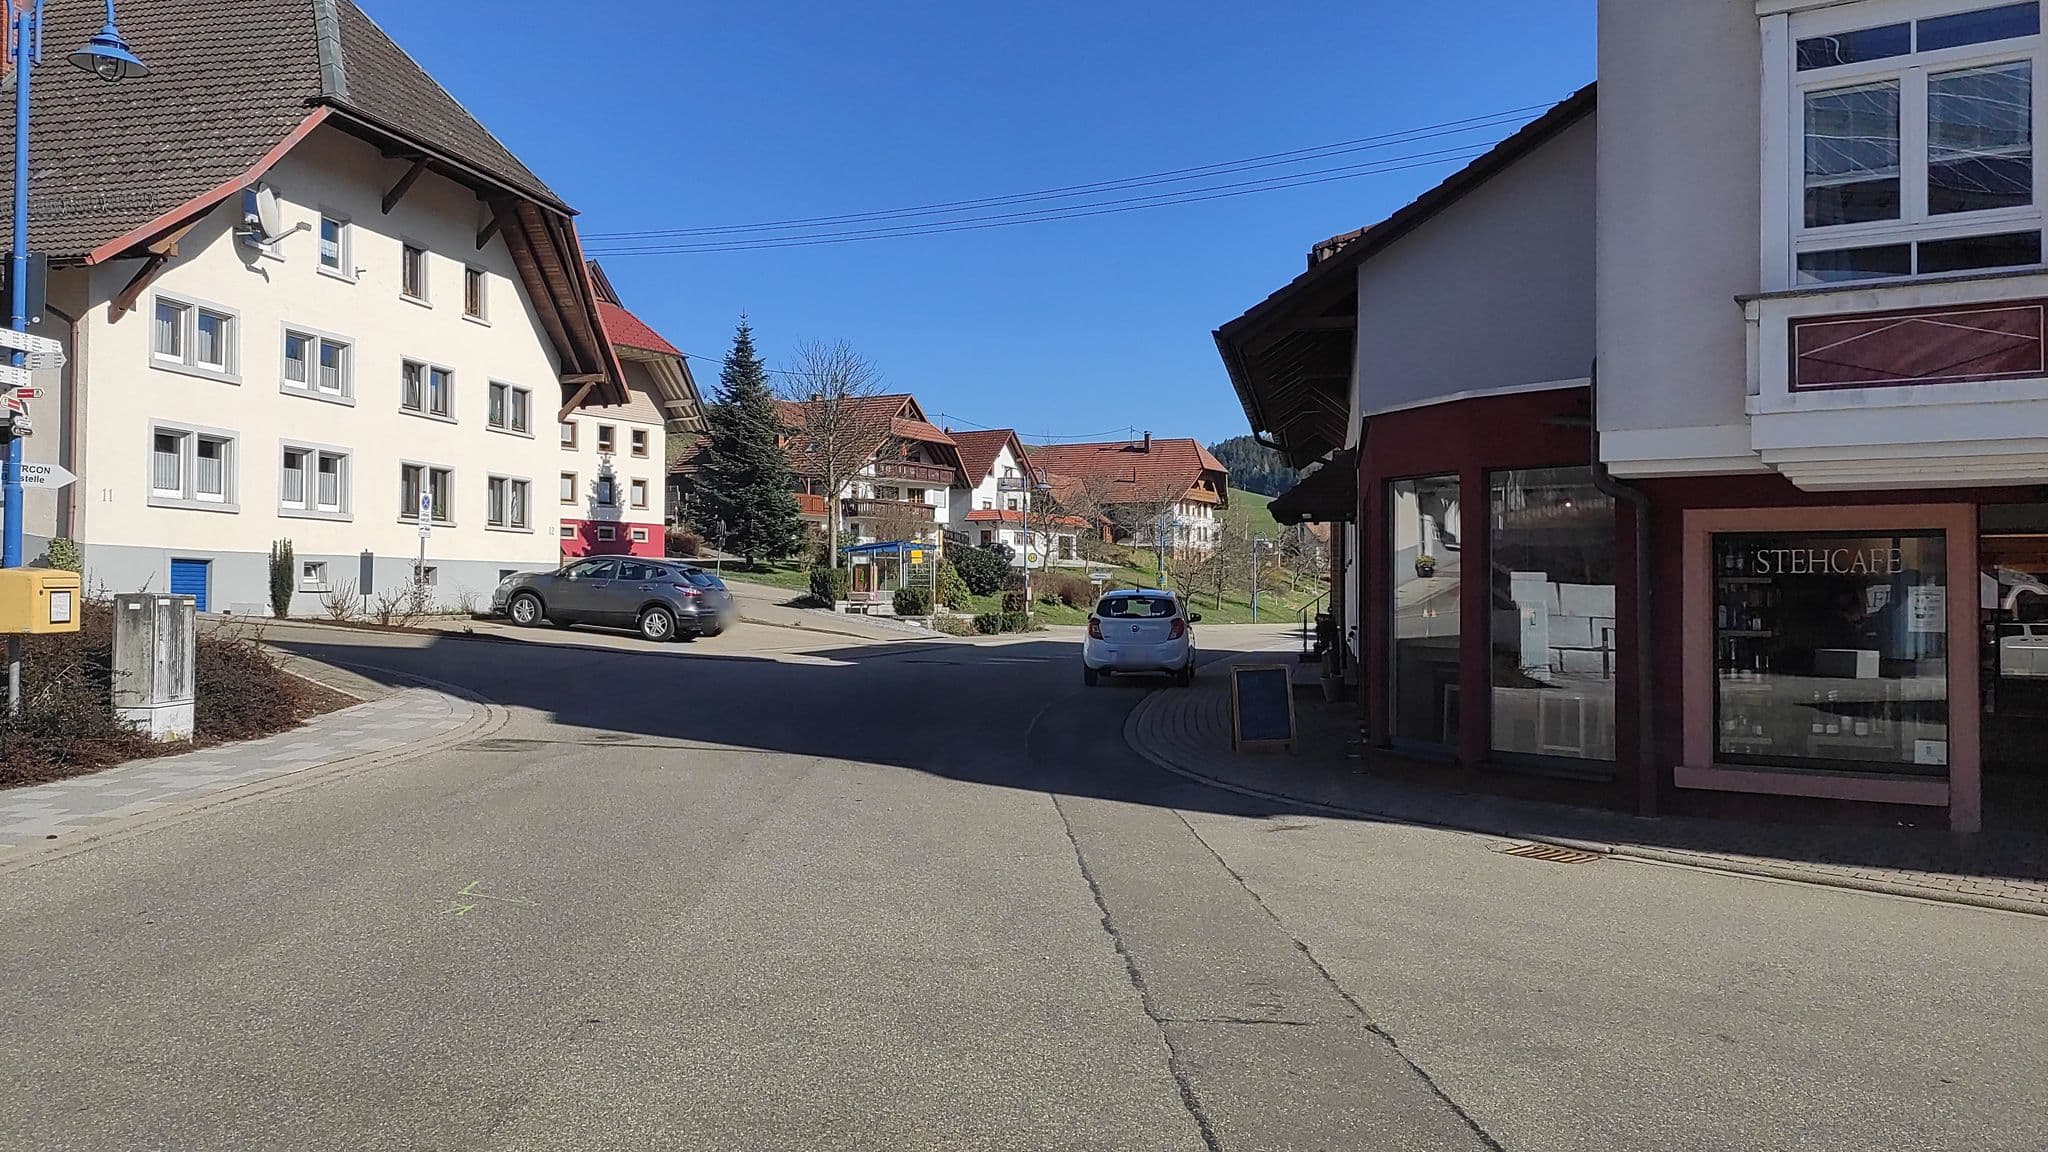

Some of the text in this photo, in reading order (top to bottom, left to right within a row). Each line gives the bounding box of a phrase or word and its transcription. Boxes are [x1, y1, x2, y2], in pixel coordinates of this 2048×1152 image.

[20, 465, 51, 475] RCON
[102, 488, 113, 502] 11
[1756, 548, 1904, 575] STEHCAFE
